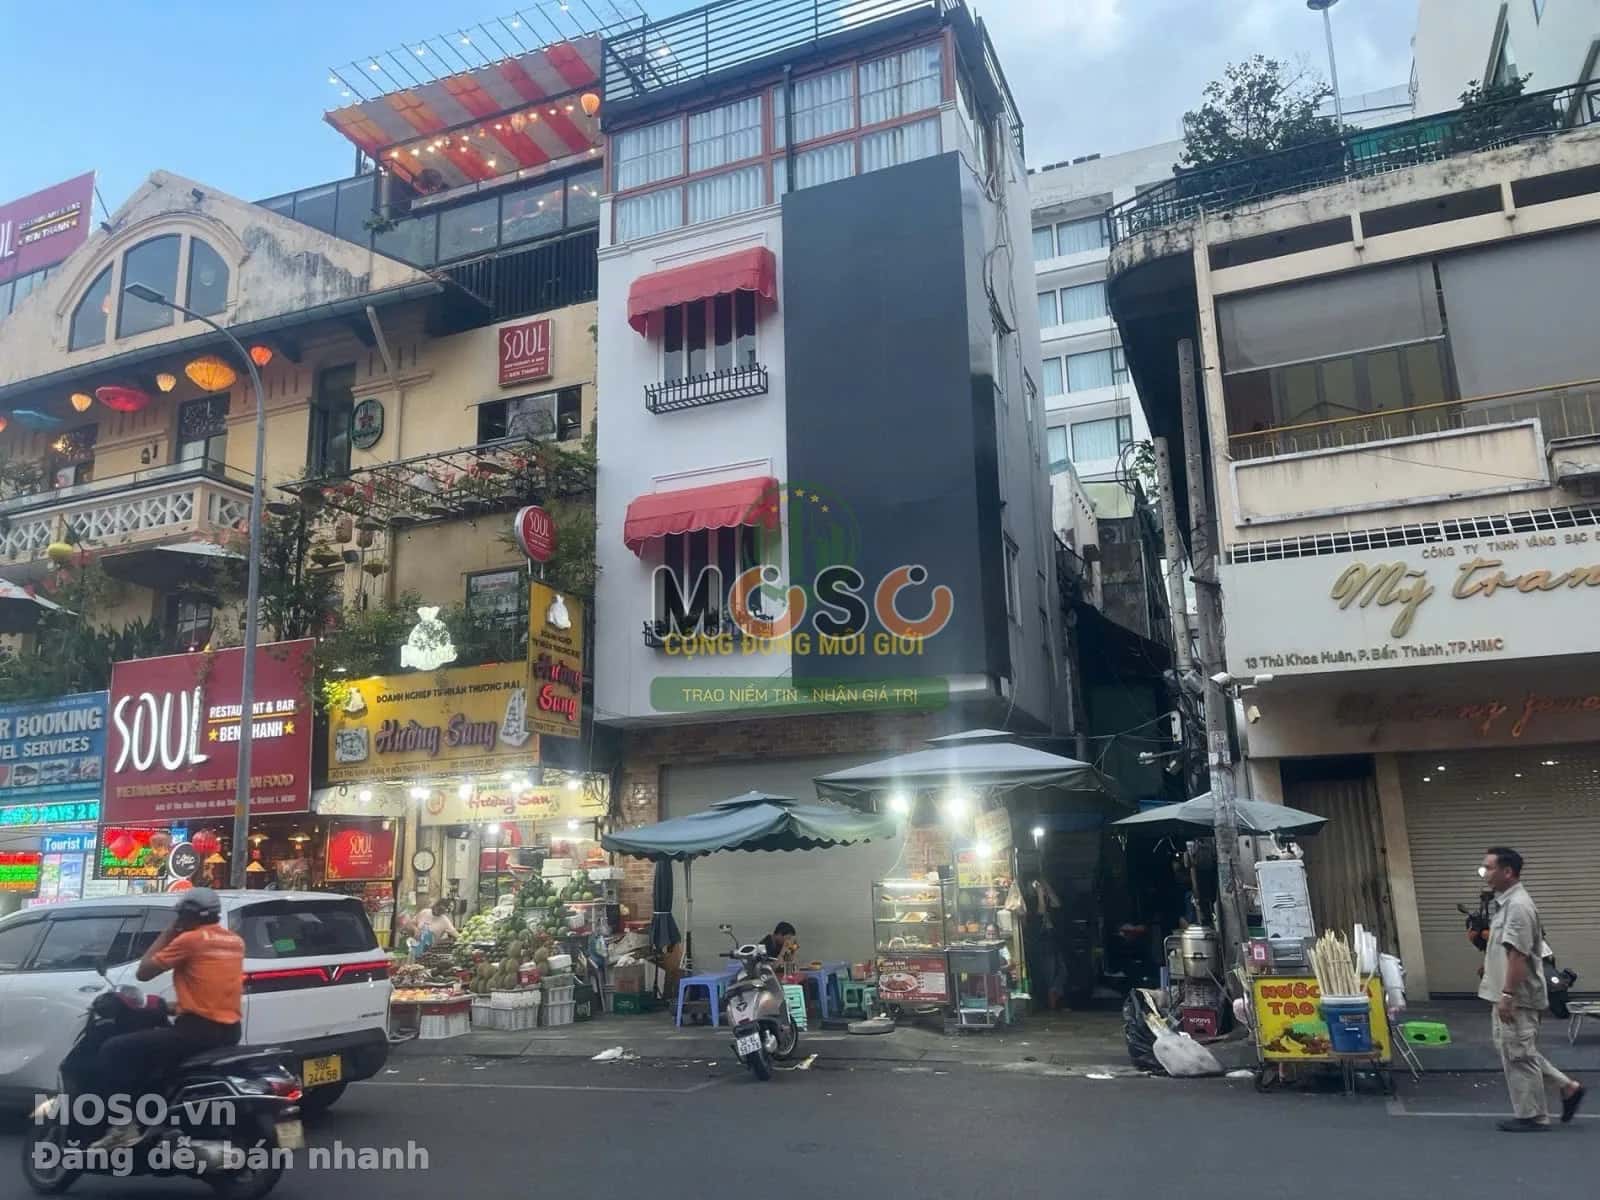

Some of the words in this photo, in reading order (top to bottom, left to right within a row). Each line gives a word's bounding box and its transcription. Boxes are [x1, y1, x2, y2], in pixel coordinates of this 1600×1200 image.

[503, 325, 546, 360] SOUL
[529, 511, 550, 537] SOUL
[1422, 545, 1456, 559] CÔNG
[1464, 543, 1479, 554] TY
[1487, 539, 1520, 552] TNHH
[1245, 656, 1258, 669] 13
[376, 692, 403, 703] DOANH
[209, 702, 264, 718] RESTAUNT
[266, 700, 273, 713] &
[276, 699, 295, 712] BAR
[16, 707, 103, 738] BOOKING
[113, 687, 209, 774] SOUL
[251, 721, 283, 739] HANH
[23, 736, 90, 757] SERVICES
[44, 836, 80, 850] Tourist
